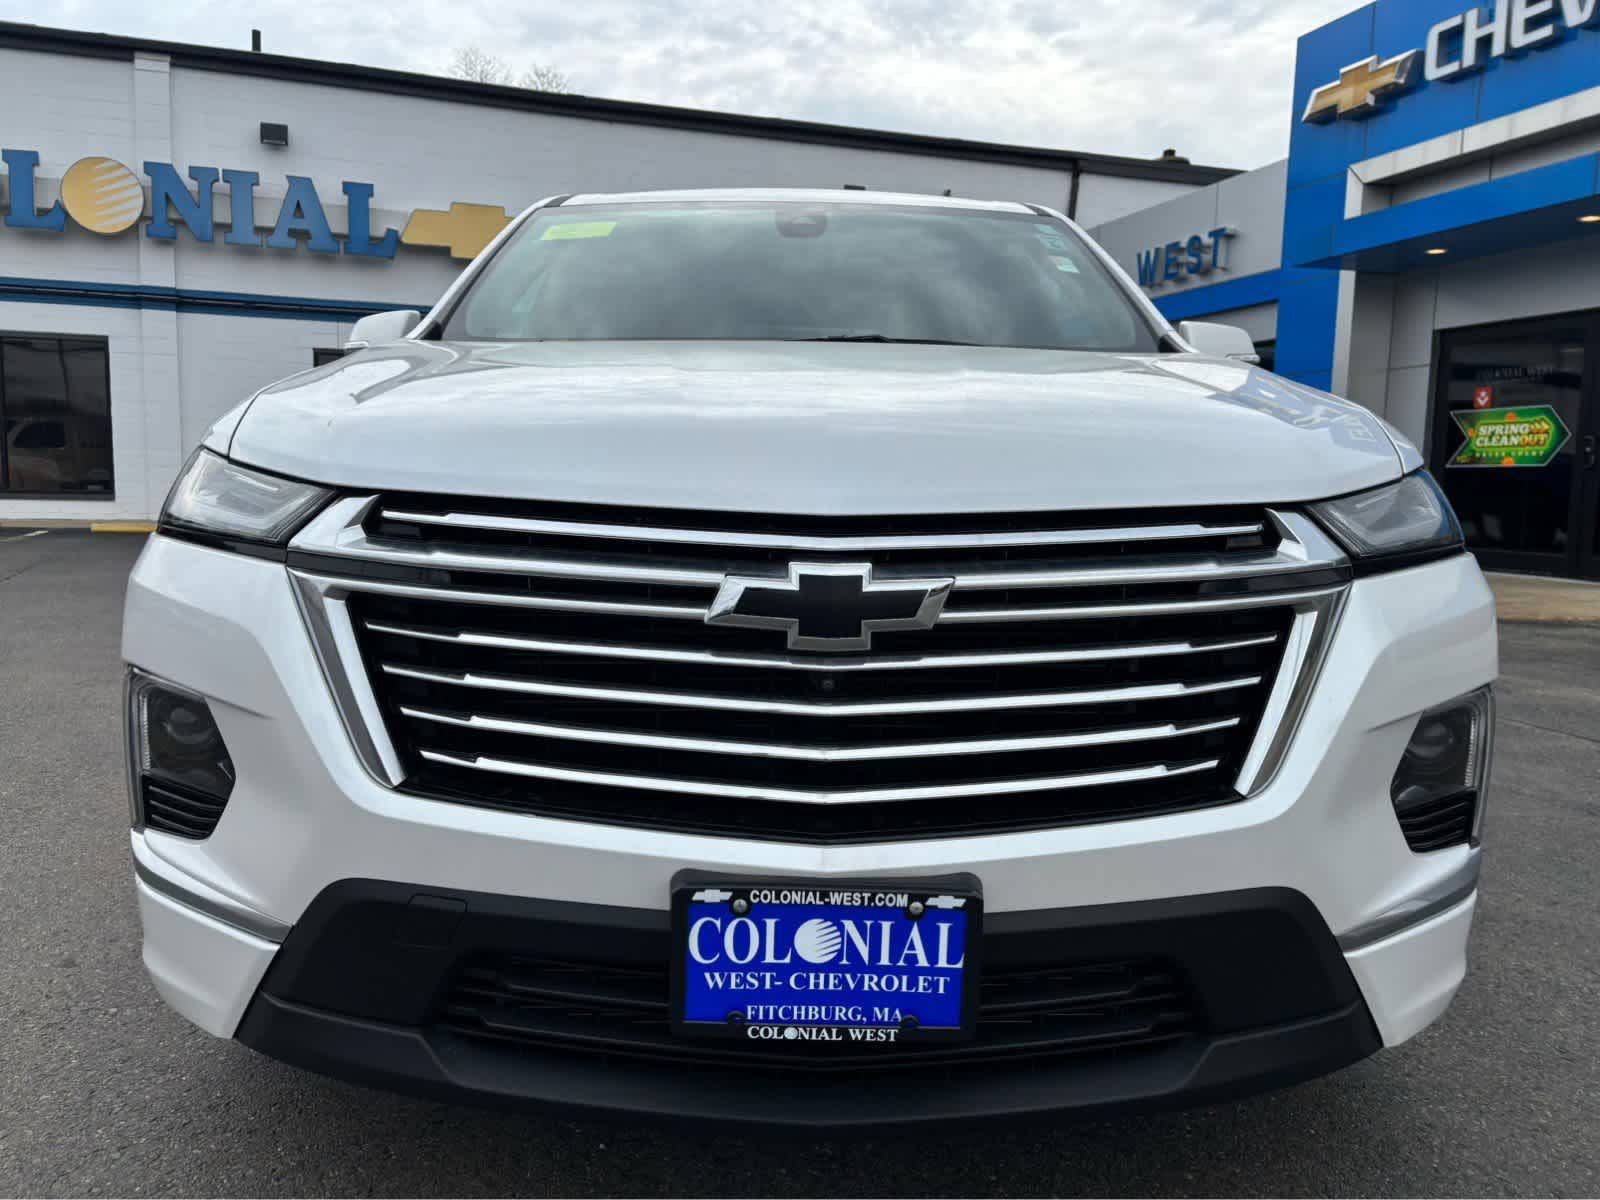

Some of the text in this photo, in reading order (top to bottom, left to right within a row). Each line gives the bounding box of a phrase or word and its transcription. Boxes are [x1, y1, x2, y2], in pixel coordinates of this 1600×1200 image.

[1136, 227, 1227, 287] WEST
[1479, 423, 1530, 436] SPRING
[1476, 433, 1548, 448] CLEANOUT
[750, 889, 909, 908] COLONIAL-WEST.COM
[688, 916, 965, 969] COLONIAL
[789, 972, 950, 994] CHEVROLET
[746, 1004, 902, 1023] FITCHBURG, MA
[747, 1025, 898, 1042] COLONIAL WEST
